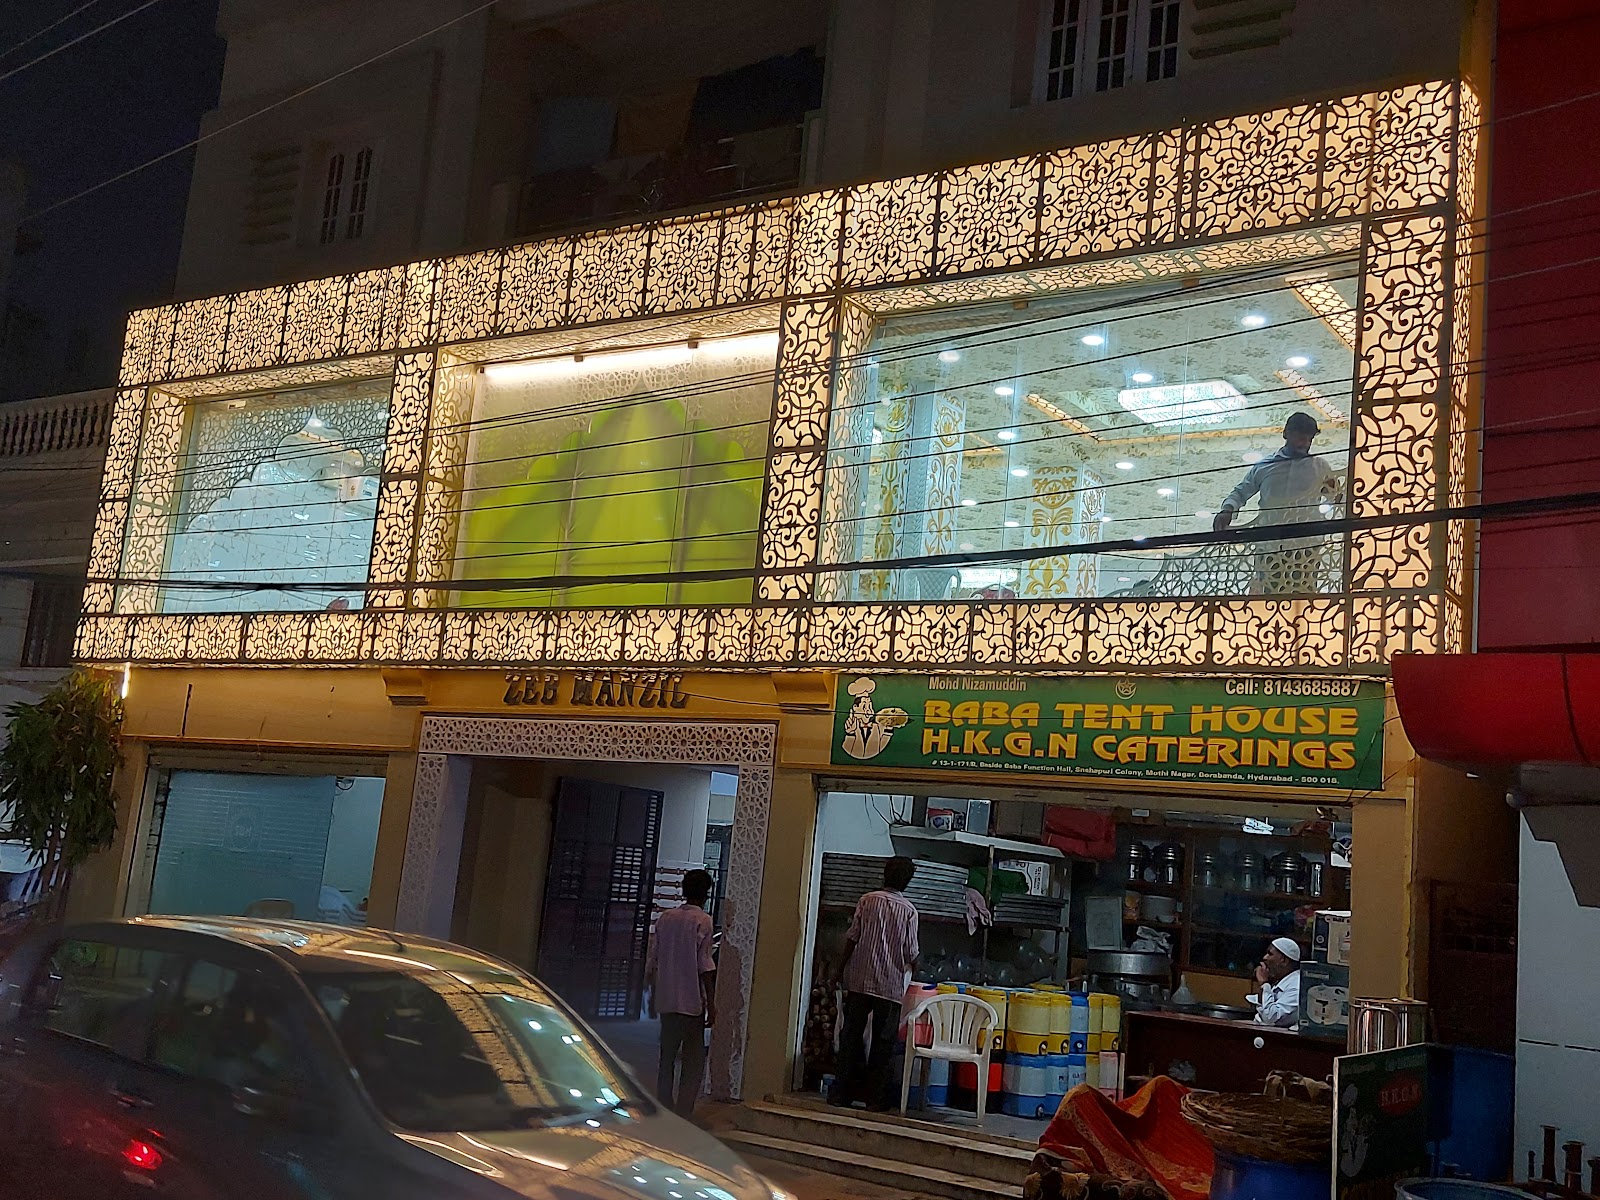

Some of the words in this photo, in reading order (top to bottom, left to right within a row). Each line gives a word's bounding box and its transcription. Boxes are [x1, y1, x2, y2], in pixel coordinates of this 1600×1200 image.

[503, 672, 560, 706] ZEB
[928, 677, 959, 690] Mohd
[962, 678, 1027, 691] Nizamuddin
[1225, 679, 1259, 695] Cell:
[1263, 679, 1360, 696] 8143685887
[923, 699, 1041, 729] BABA
[1054, 702, 1175, 730] TENT
[1189, 705, 1359, 736] HOUSE
[921, 728, 1079, 760] H.K.G.N
[1092, 734, 1356, 770] CATERINGS
[1023, 763, 1055, 772] Function
[1114, 768, 1144, 777] Colony,
[1247, 773, 1293, 782] Hyderabad
